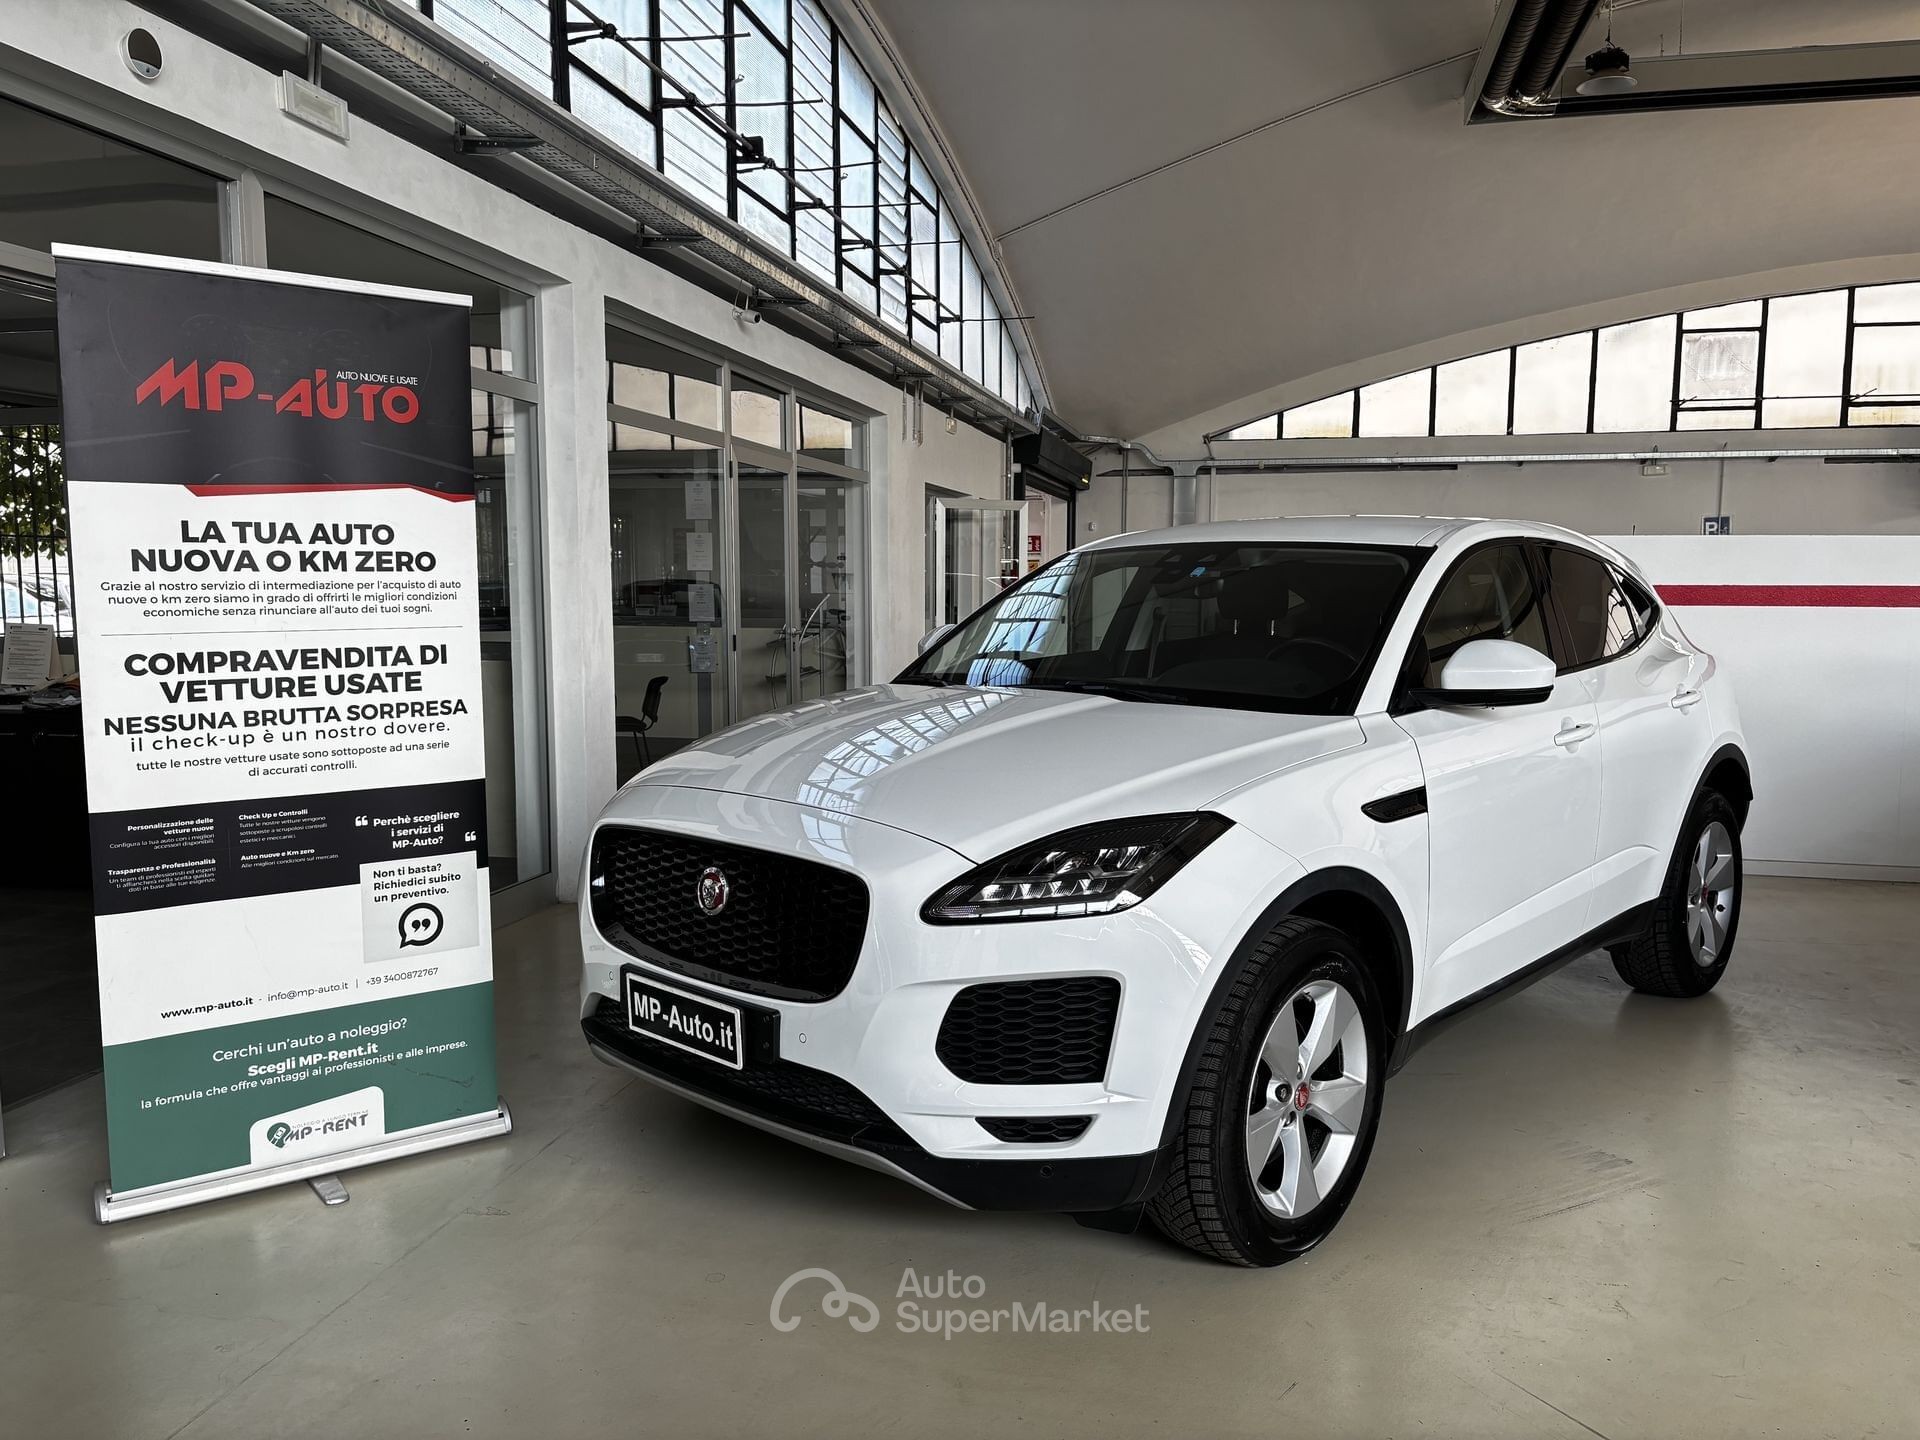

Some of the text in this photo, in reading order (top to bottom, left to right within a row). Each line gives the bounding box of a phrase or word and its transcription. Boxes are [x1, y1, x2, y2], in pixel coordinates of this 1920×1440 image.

[336, 370, 418, 385] AUTO NUOVE E USATE
[136, 357, 420, 424] MP-AUTO
[181, 520, 395, 545] LA TUA AUTO
[131, 549, 260, 572] NUOVA
[299, 550, 348, 572] KM
[355, 551, 437, 572] ZERO
[100, 580, 462, 592] Grazie al nostro servizio di intermediazione per l'acquisto di auto
[108, 591, 458, 605] nuove o km zero siamo in grado di offrirti le migliori condizioni
[143, 604, 433, 617] economiche senza rinunciare all'auto dei tuoi sogni.
[124, 644, 448, 676] COMPRAVENDITA DI
[159, 671, 423, 704] VETTURE USATE
[104, 699, 468, 736] NESSUNA BRUTTA SORPRESA
[131, 721, 450, 752] il check-up è un nostro dovere.
[136, 740, 450, 771] tutte le nostre vetture usate sono sottoposte ad una serie
[248, 760, 357, 776] di accurati controlli.
[278, 809, 308, 817] Controlli
[413, 811, 460, 823] scegliere
[127, 820, 195, 831] Personalizzazione
[391, 823, 444, 837] i servizi di
[392, 836, 444, 849] MP-Auto?
[373, 863, 442, 879] Non ti basta?
[374, 873, 461, 891] Richiedici subito
[374, 887, 450, 903] un preventivo.
[161, 967, 439, 1019] www.mp-auto.it info@mp-auto.it +39 3400872767
[633, 991, 734, 1052] MP-Auto.it
[212, 1017, 407, 1062] Cerchi un'auto a noleggio?
[247, 1042, 379, 1078] Scegli MP-Rent.it
[141, 1100, 152, 1109] la
[155, 1090, 203, 1106] formula
[206, 1086, 228, 1096] che
[231, 1080, 258, 1092] offre
[260, 1068, 309, 1086] vantaggi
[312, 1066, 322, 1076] ai
[325, 1052, 394, 1076] professionisti
[405, 1048, 424, 1058] alle
[426, 1041, 468, 1054] imprese.
